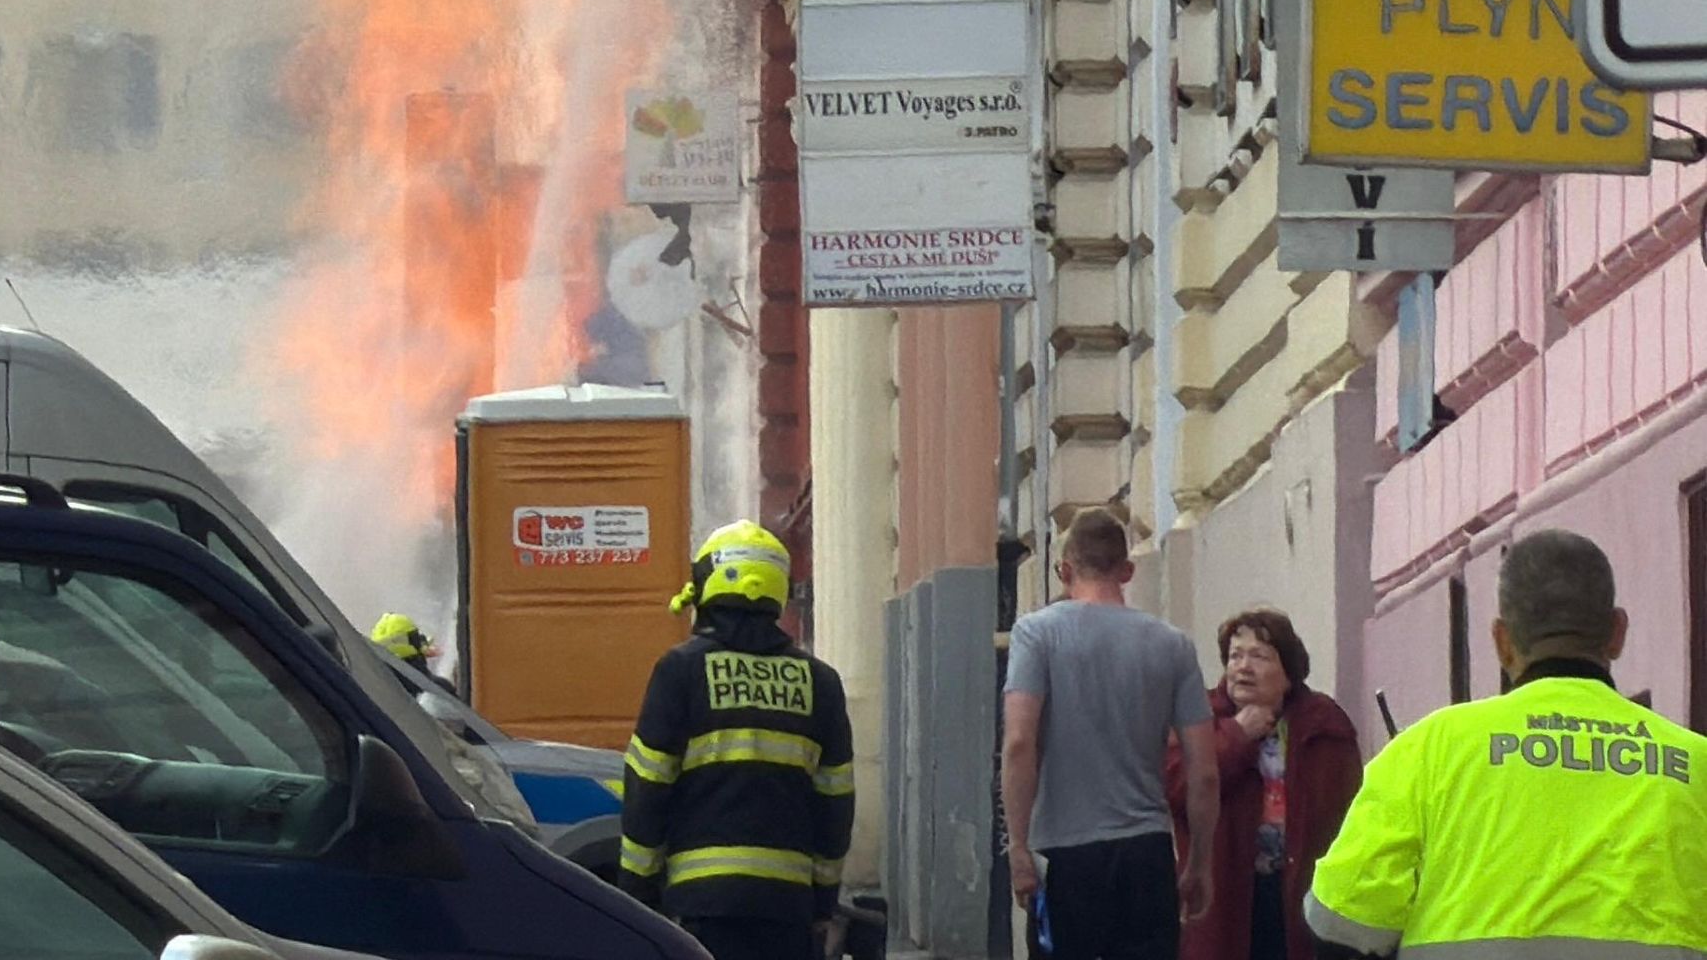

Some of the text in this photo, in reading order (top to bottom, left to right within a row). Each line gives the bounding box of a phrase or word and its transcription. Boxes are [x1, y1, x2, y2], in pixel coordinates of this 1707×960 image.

[805, 89, 1022, 119] VELVET Voyages s.r.o.
[1327, 68, 1629, 137] SERVIS
[811, 229, 1024, 251] HARMONIE SRDCE
[539, 549, 640, 564] 773 237 237
[714, 681, 807, 711] PRAHA
[1489, 732, 1690, 785] POLICIE
